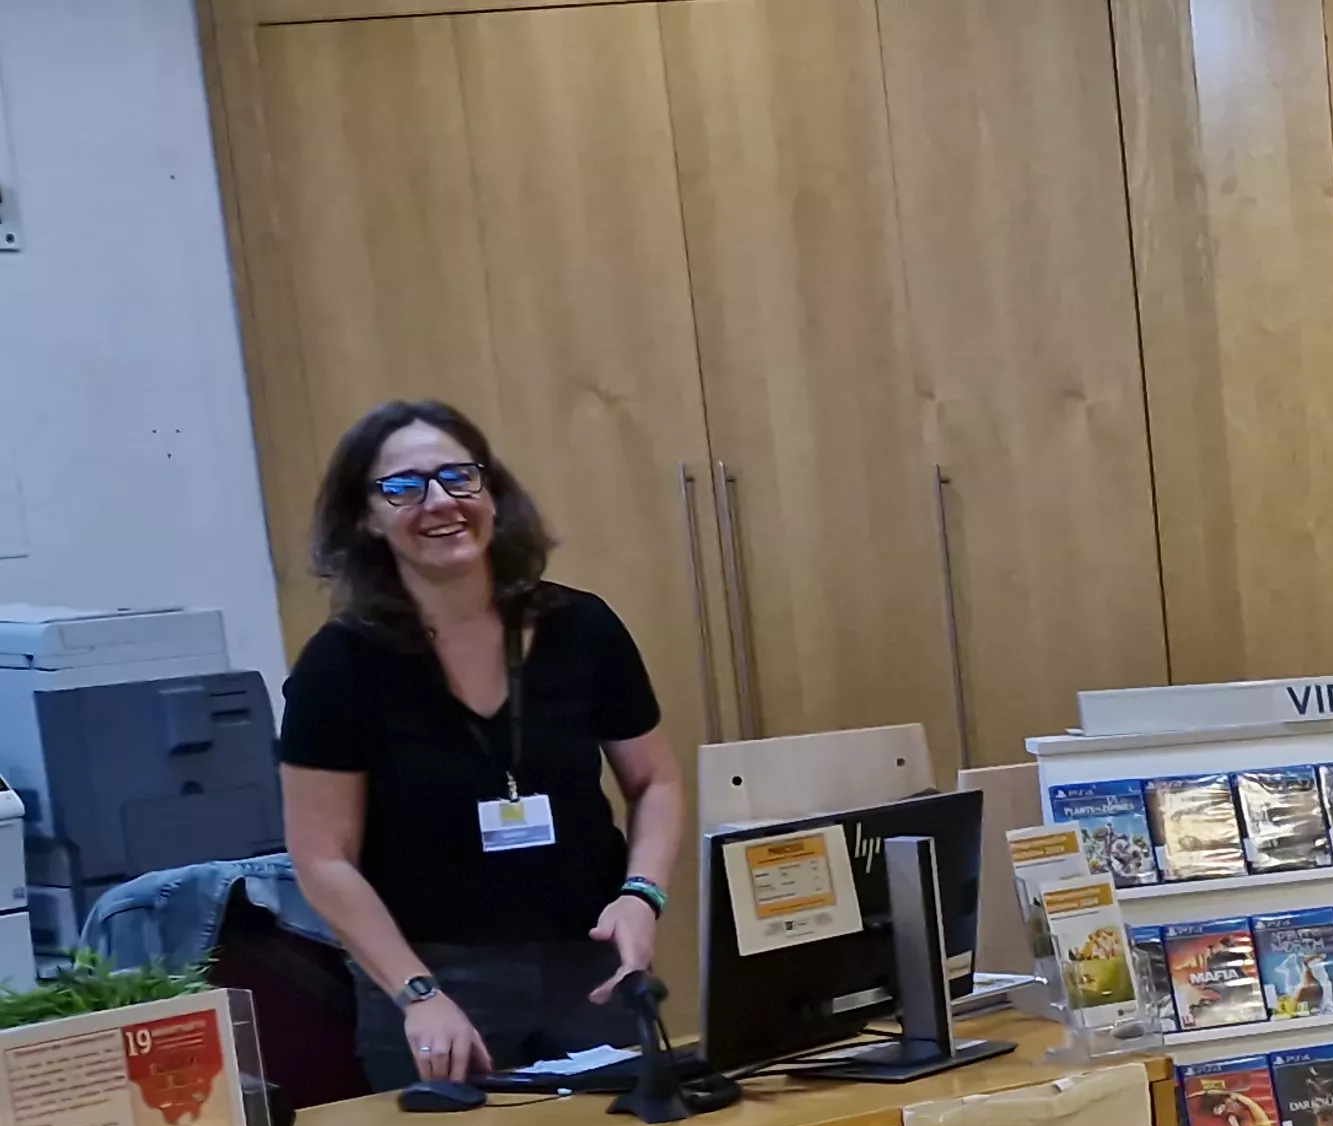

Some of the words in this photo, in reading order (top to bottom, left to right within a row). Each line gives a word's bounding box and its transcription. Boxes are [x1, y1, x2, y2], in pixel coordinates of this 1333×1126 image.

[854, 821, 882, 874] hp
[1189, 968, 1240, 985] MAFIA
[125, 1029, 153, 1057] 19
